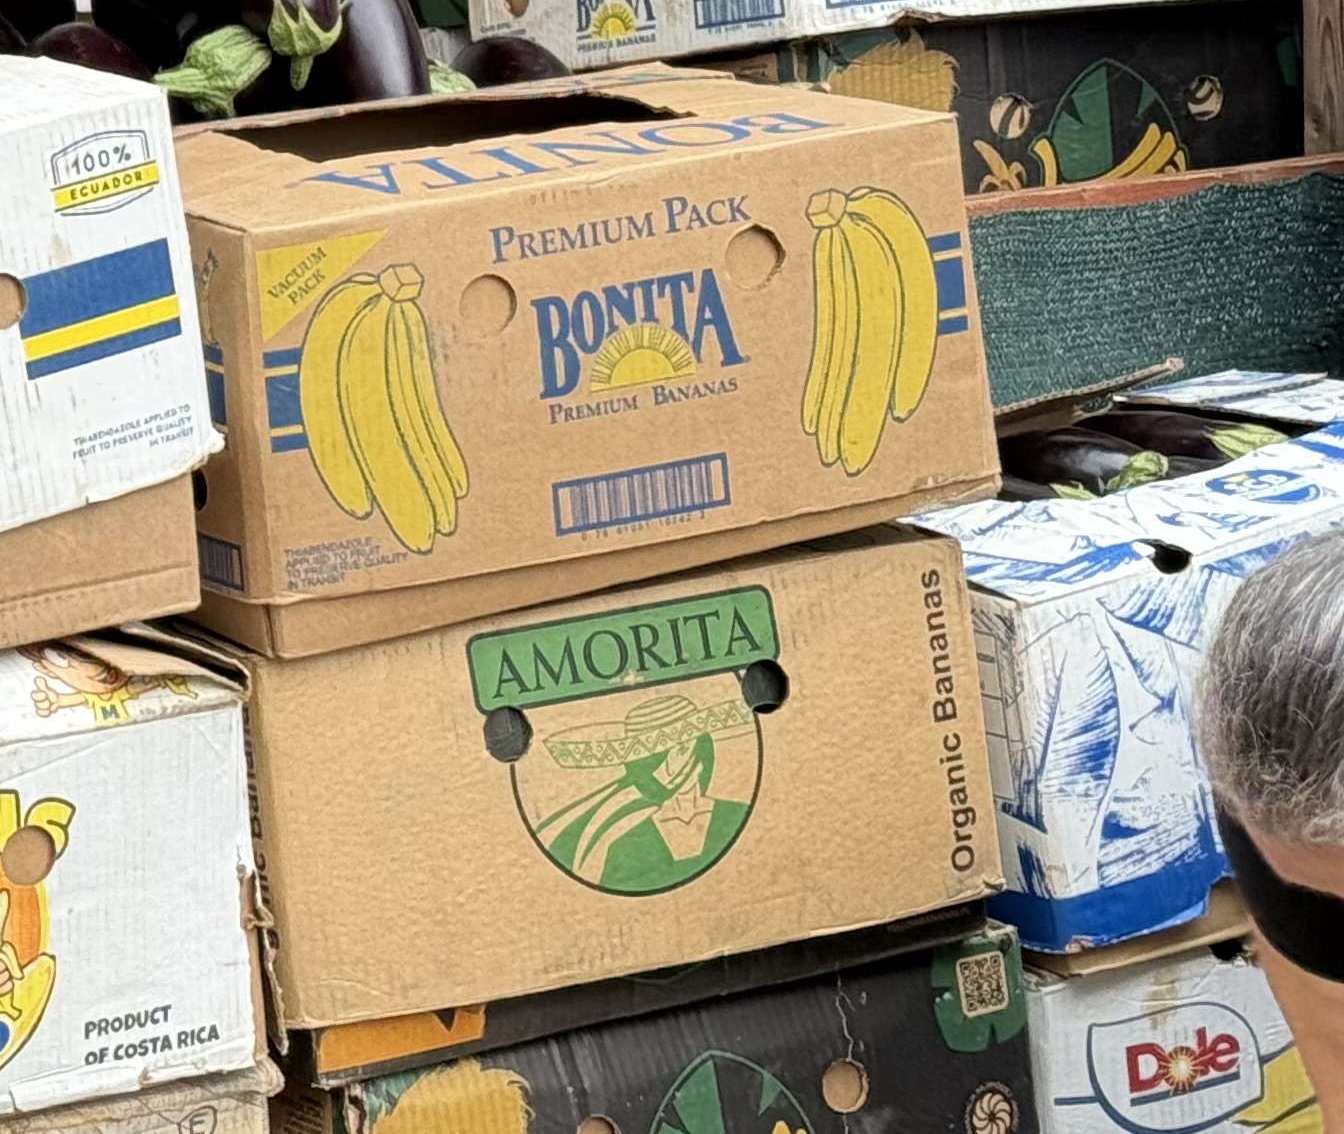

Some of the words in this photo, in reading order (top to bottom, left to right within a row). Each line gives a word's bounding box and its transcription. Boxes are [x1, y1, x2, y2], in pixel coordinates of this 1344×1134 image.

[71, 143, 132, 176] 100%
[303, 112, 833, 195] BONITA
[70, 170, 143, 201] ECUADOR
[489, 211, 656, 265] PREMIUM
[662, 195, 752, 235] PACK
[267, 246, 327, 300] VACUUM
[286, 267, 327, 306] PACK
[530, 267, 750, 400] BONITA
[143, 407, 178, 425] APPLIED
[178, 403, 191, 414] TO
[548, 394, 639, 424] PREMIUM
[651, 377, 739, 407] BANANAS
[72, 443, 97, 460] FRUIT
[98, 440, 112, 452] TO
[155, 414, 193, 434] QUALITY
[149, 438, 160, 448] IN
[161, 425, 194, 444] TRANSIT
[491, 604, 764, 700] AMORITA
[920, 567, 959, 724] Bananas
[943, 732, 978, 873] Organic
[84, 1004, 173, 1040] PRODUCT
[84, 1048, 109, 1067] OF
[113, 1035, 174, 1063] COSTA
[178, 1023, 221, 1051] RICA
[1125, 1028, 1242, 1096] Dole
